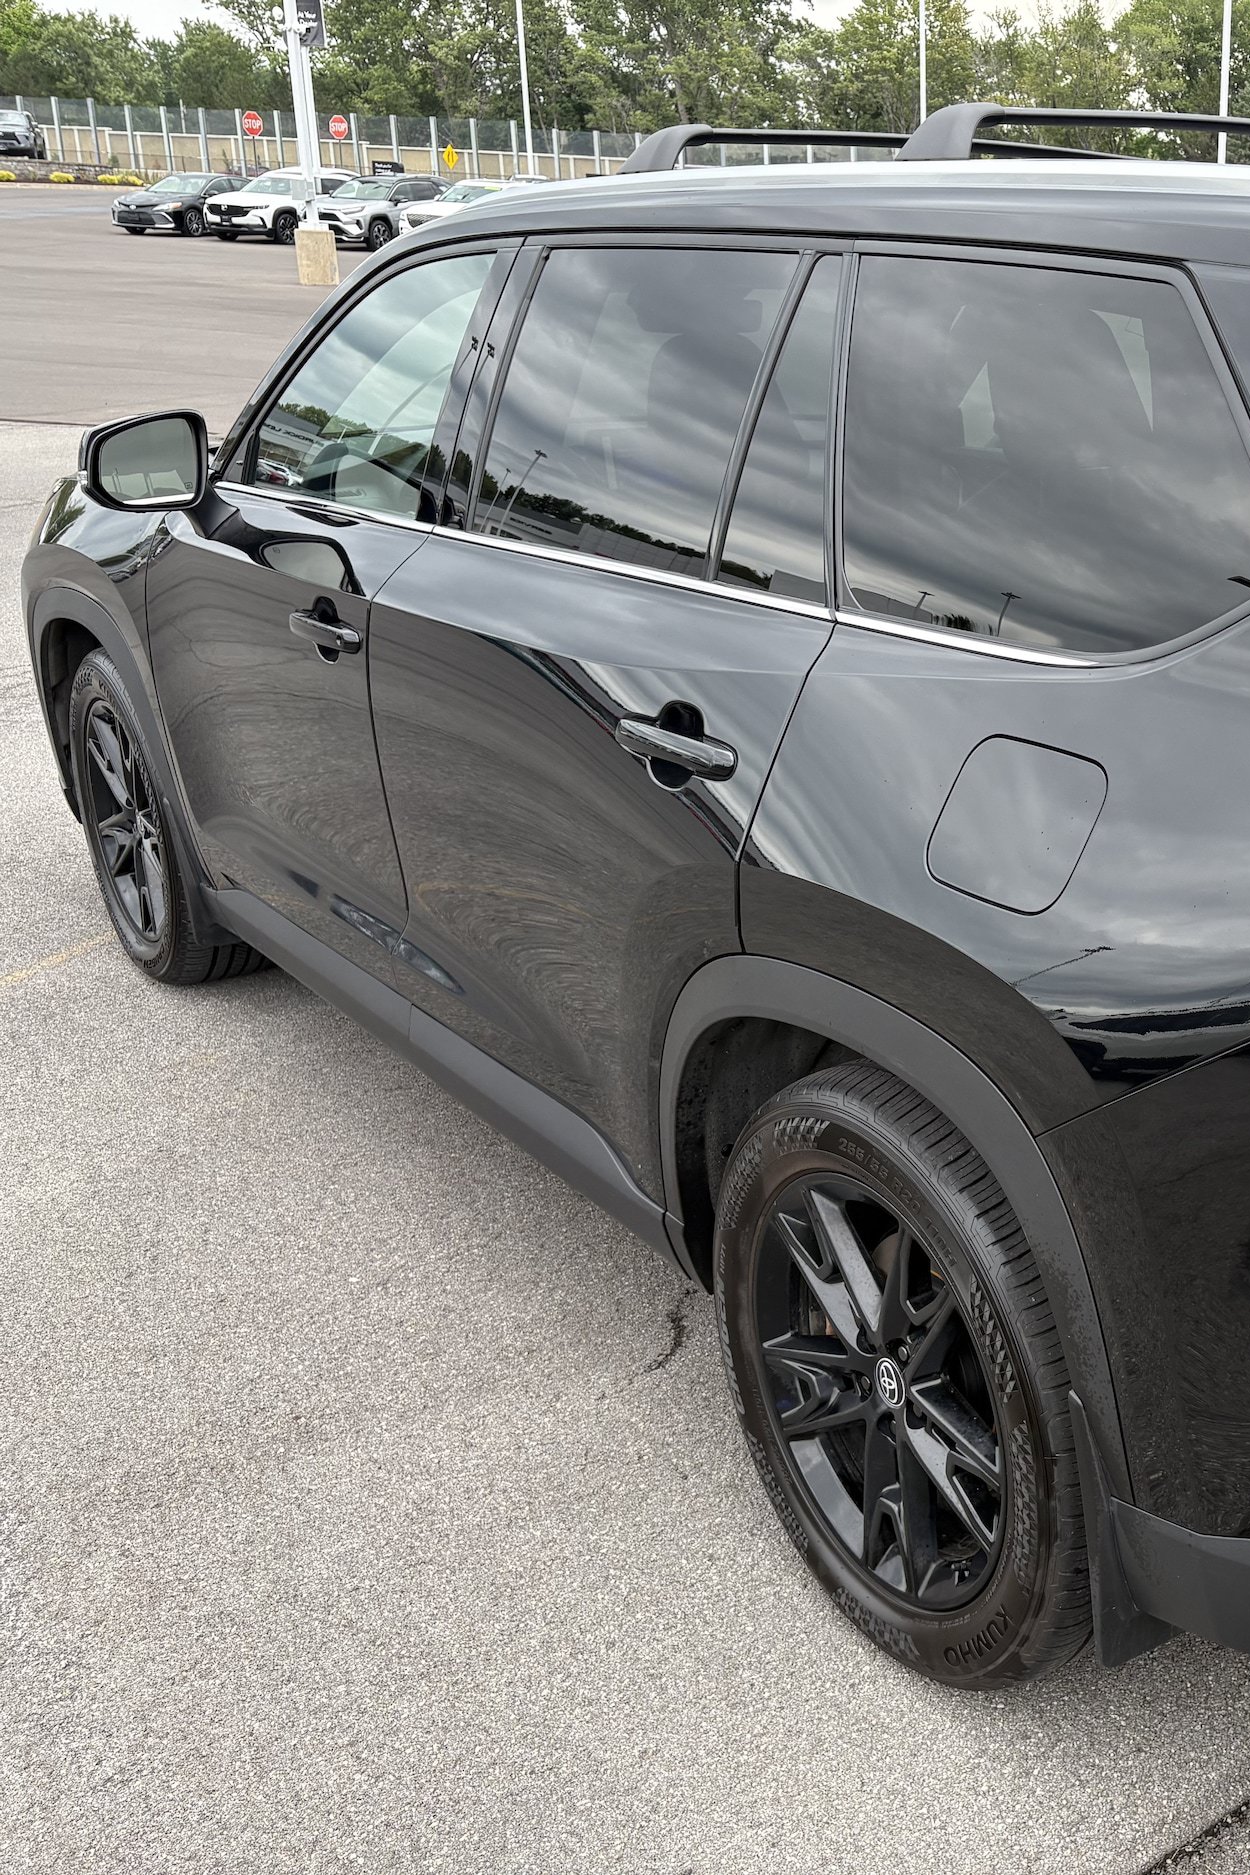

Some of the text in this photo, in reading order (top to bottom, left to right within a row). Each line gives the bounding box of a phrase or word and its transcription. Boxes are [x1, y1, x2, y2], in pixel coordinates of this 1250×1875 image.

[244, 119, 261, 129] STOP
[331, 122, 347, 132] STOP
[943, 1602, 1017, 1669] KUMHO
